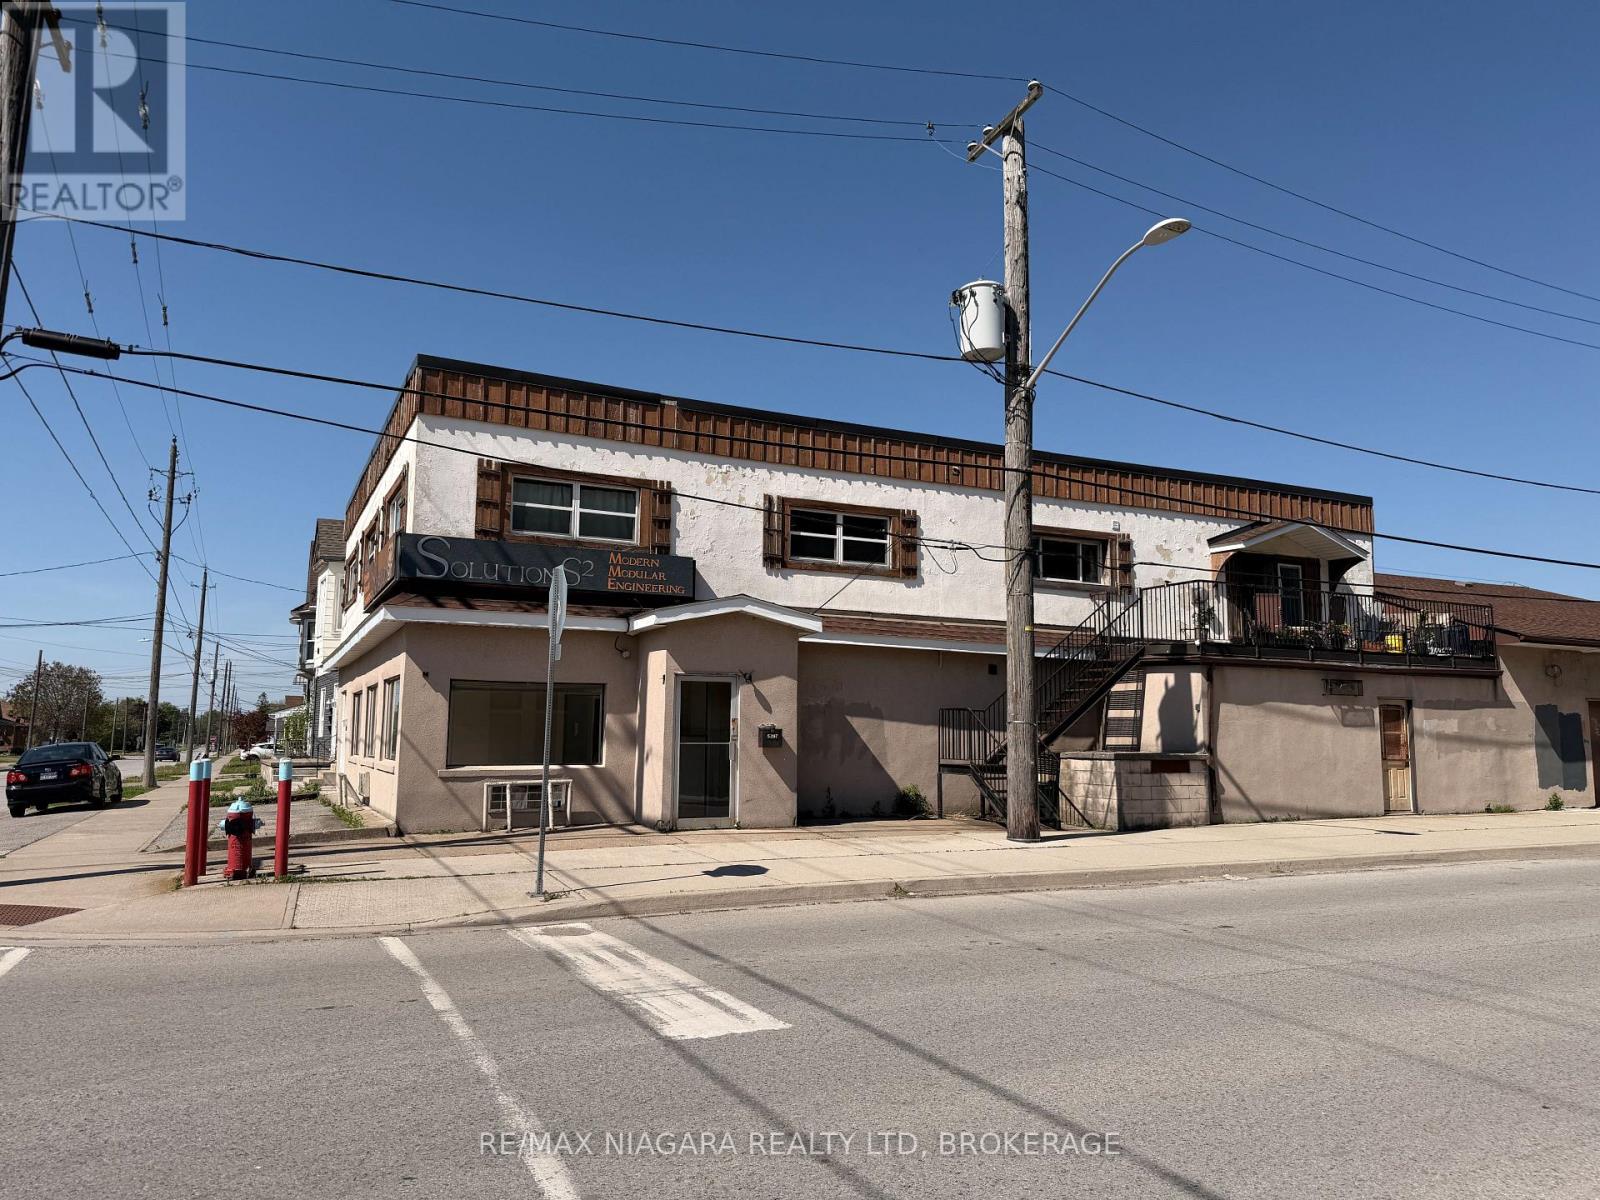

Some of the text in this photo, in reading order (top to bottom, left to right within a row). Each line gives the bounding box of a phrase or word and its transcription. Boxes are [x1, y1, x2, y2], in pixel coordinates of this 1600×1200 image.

[608, 551, 660, 568] MODERN
[608, 565, 667, 581] MODULAR
[607, 578, 686, 594] ENGINEERING
